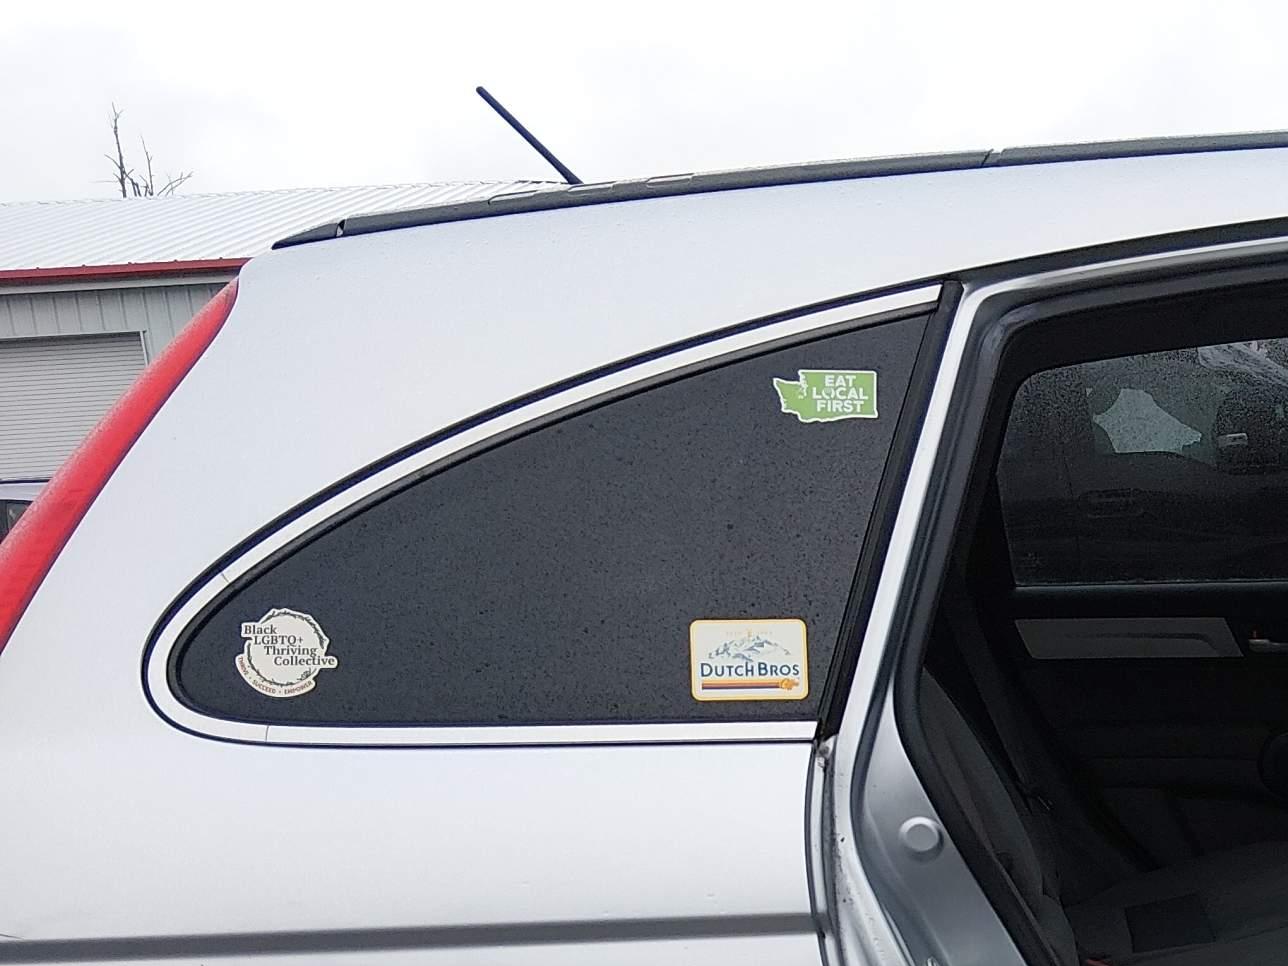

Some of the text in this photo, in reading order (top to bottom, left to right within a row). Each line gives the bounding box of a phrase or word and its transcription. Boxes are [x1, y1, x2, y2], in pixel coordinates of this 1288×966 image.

[824, 375, 857, 387] EAT
[812, 387, 869, 400] LOCAL
[816, 400, 865, 412] FIRST
[244, 624, 277, 635] Black
[253, 635, 304, 647] LGBTQ+
[263, 645, 318, 658] Thriving
[273, 655, 335, 666] Collective
